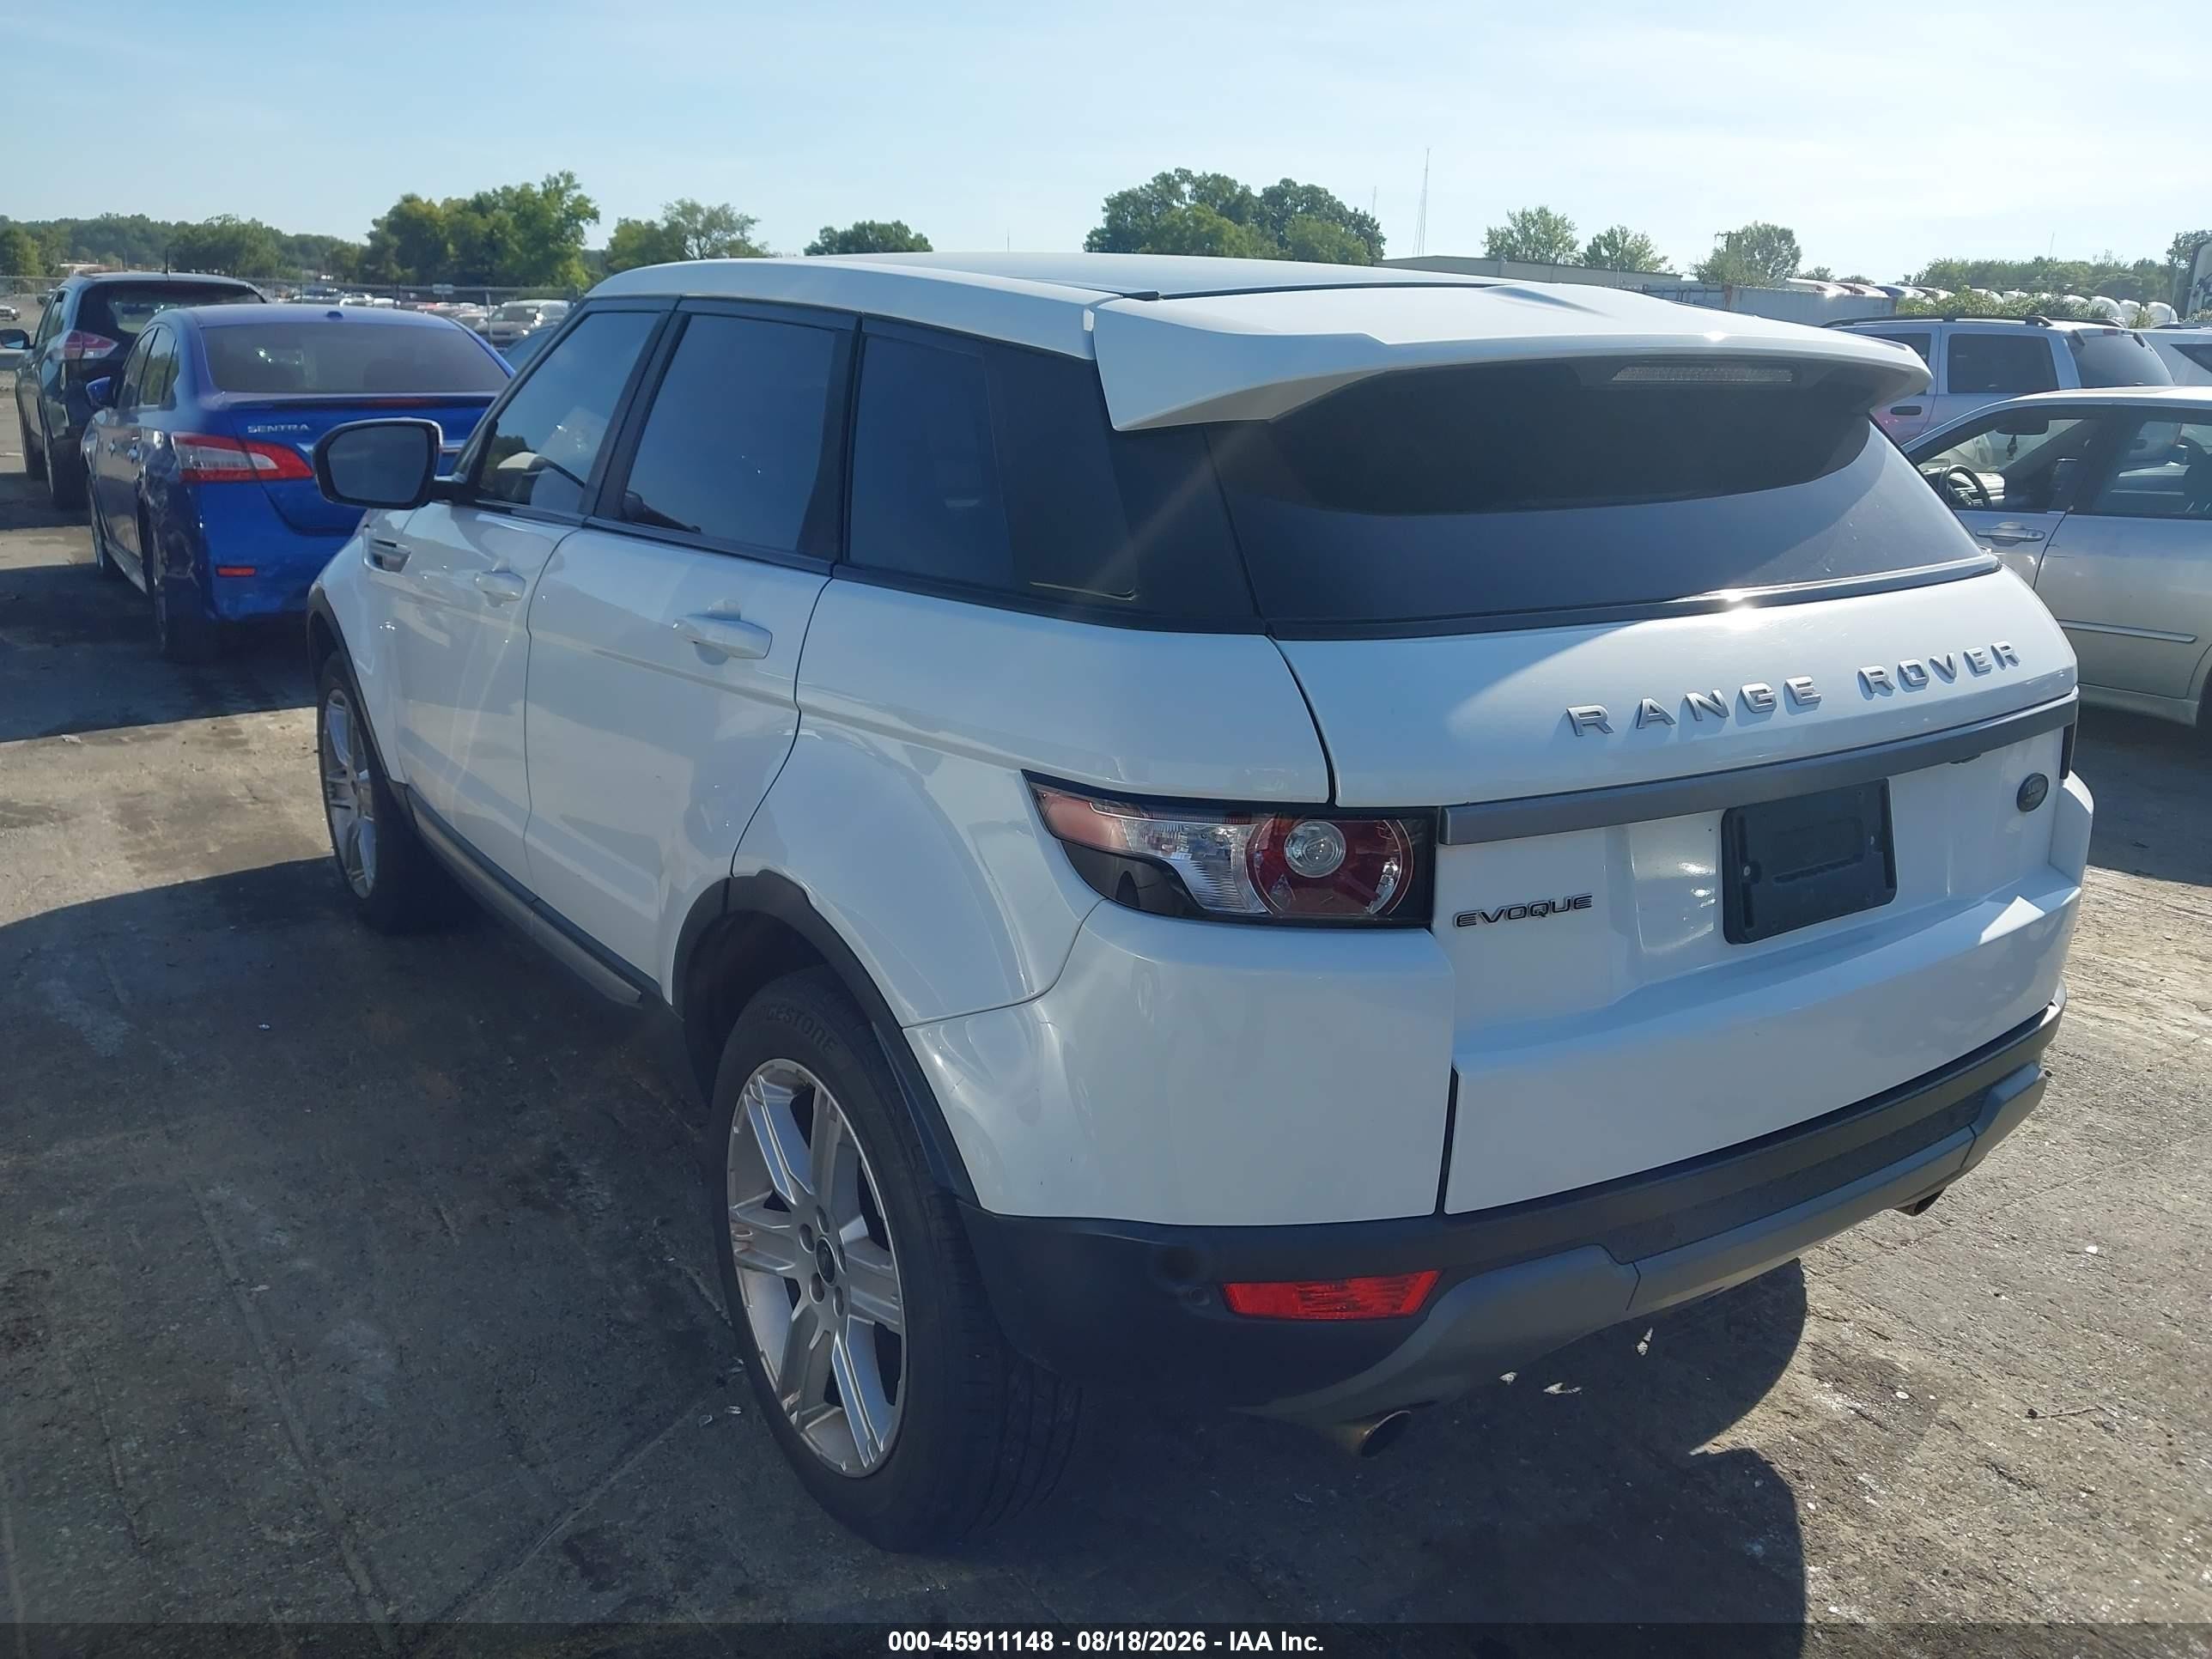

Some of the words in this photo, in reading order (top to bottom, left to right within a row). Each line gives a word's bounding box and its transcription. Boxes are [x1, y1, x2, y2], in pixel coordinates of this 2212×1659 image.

[247, 423, 310, 434] SENTRA
[1565, 675, 1822, 737] RANGE
[1857, 640, 2021, 692] ROVER
[1453, 892, 1594, 928] EVOQUE
